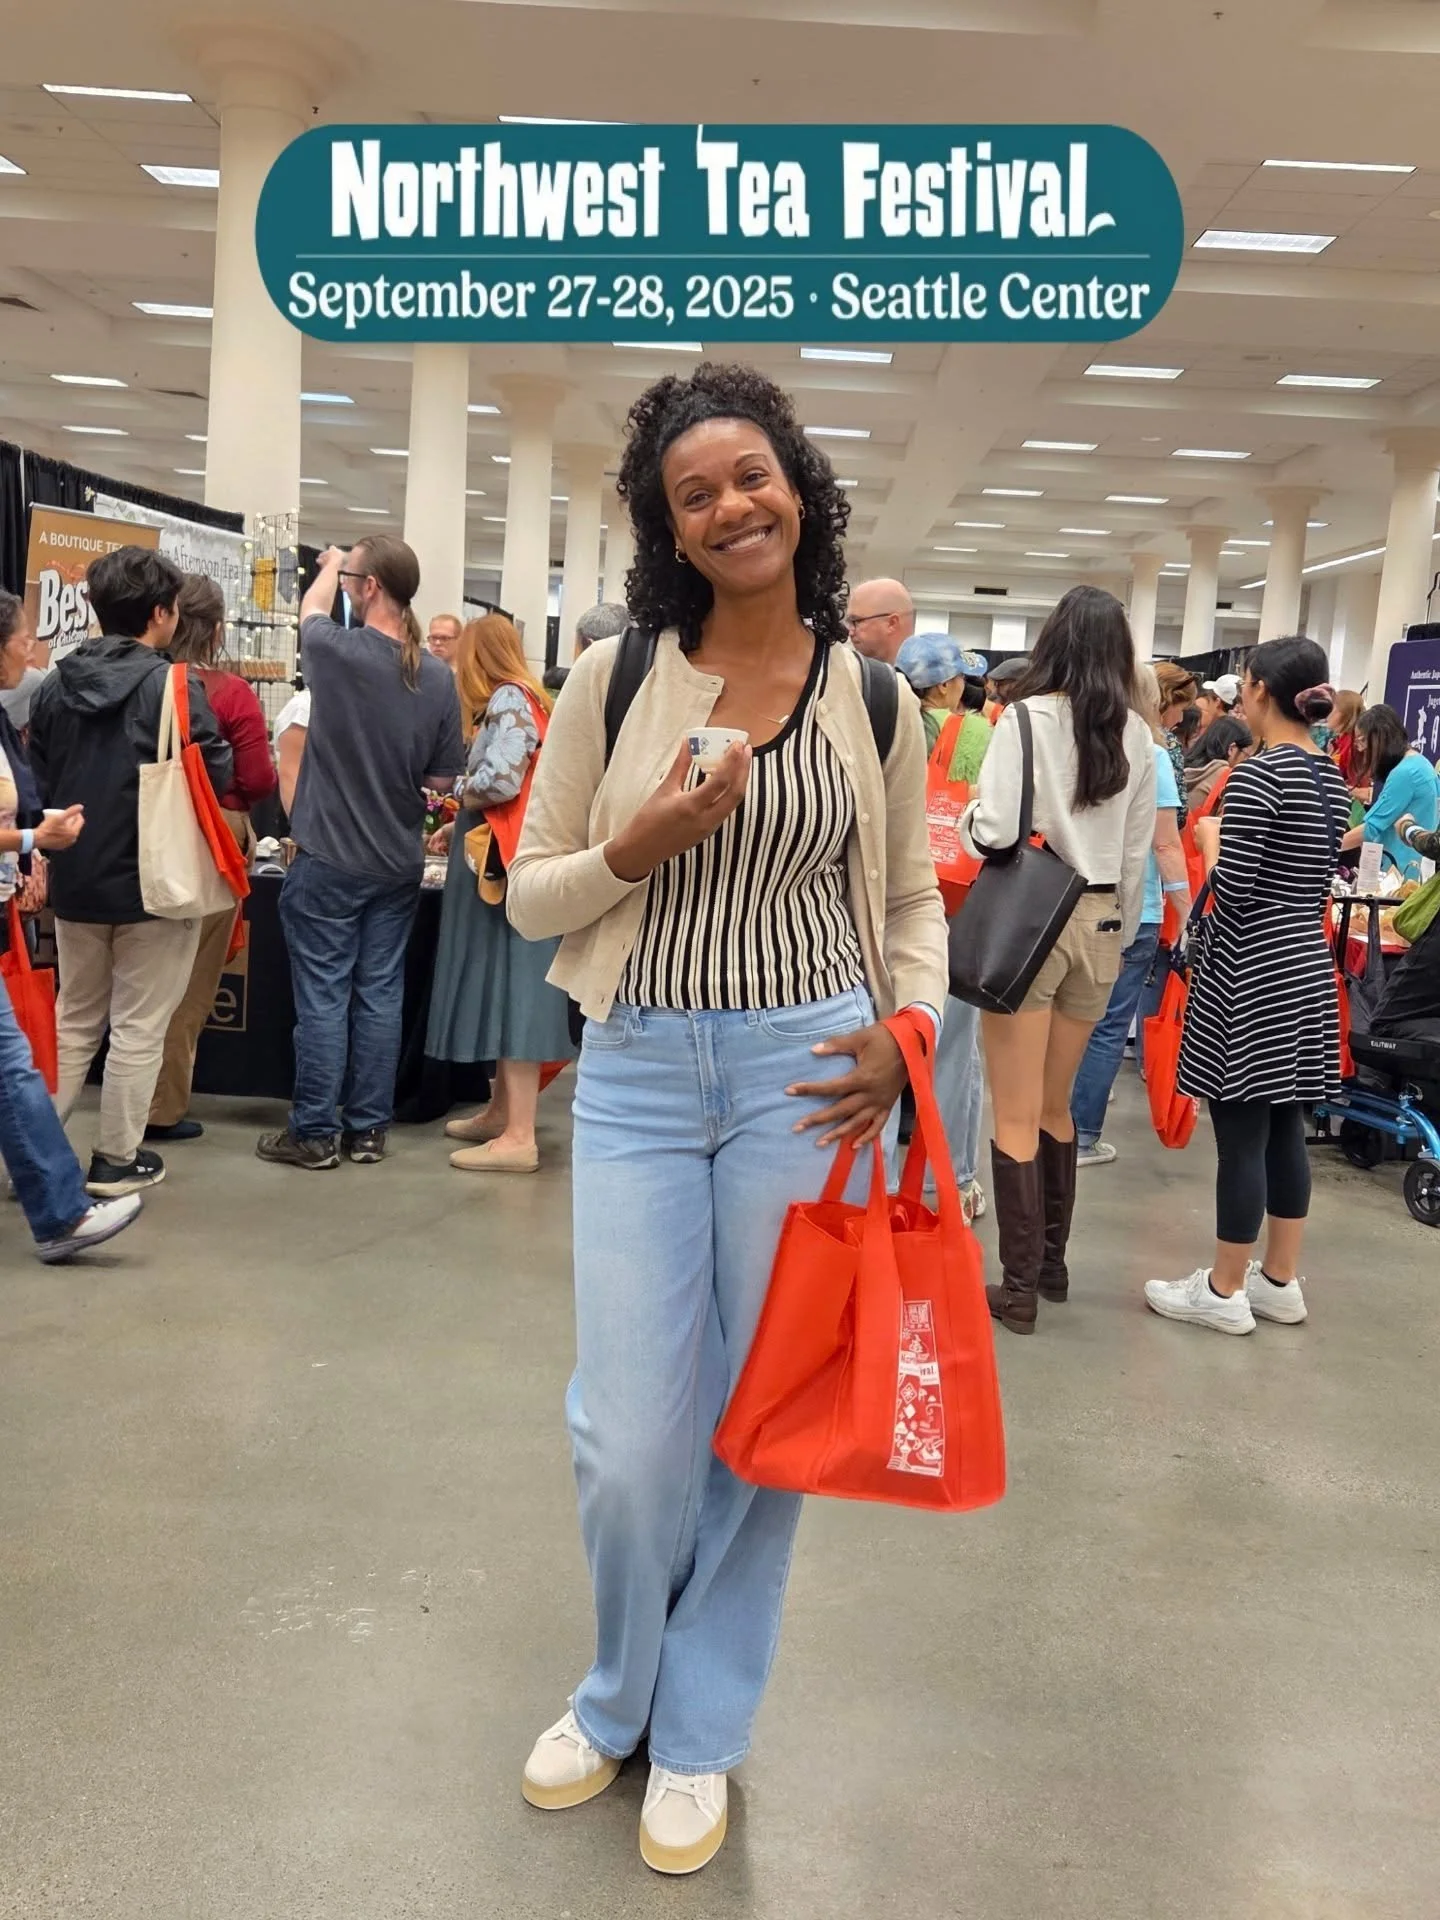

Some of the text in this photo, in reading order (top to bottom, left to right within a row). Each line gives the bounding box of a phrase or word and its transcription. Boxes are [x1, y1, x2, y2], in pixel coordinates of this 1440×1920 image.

[39, 531, 124, 553] A BOUTIQUE TE
[222, 557, 239, 579] Tea
